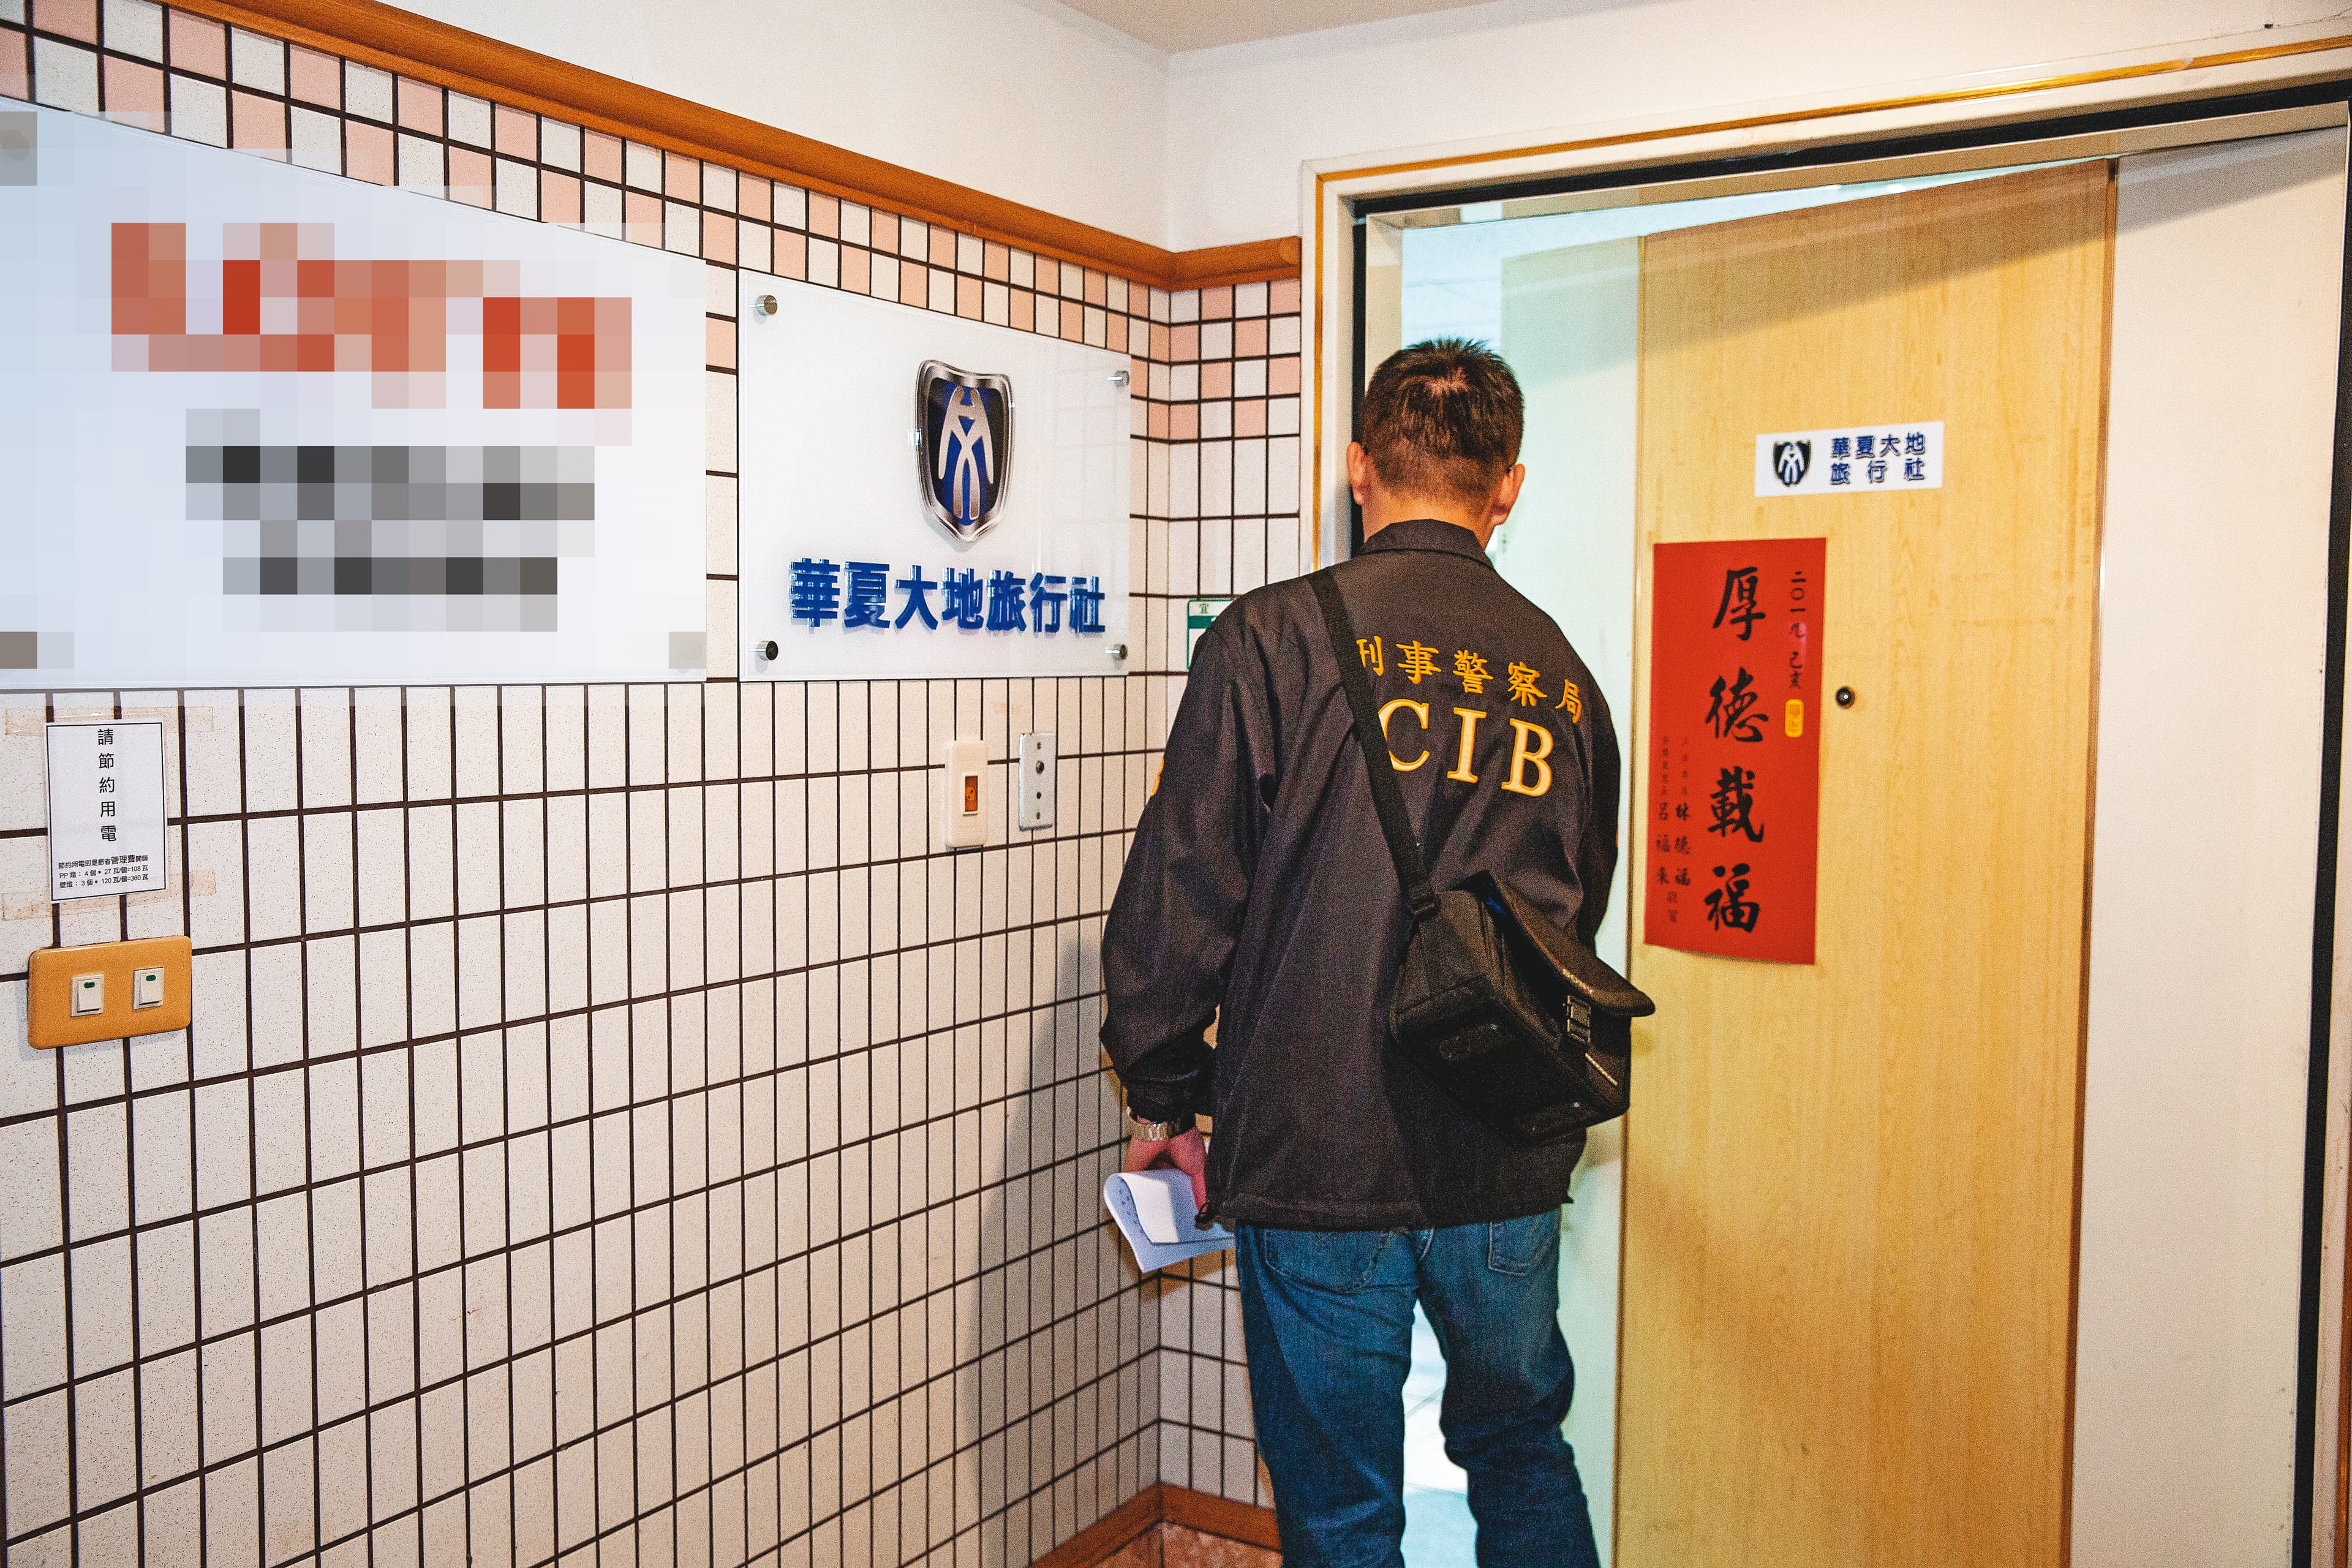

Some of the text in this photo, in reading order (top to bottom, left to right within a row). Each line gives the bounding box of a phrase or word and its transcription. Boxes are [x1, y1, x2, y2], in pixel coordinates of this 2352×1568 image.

[1830, 458, 1925, 485] 旅行社
[1831, 432, 1926, 458] 華夏大地
[788, 557, 1106, 633] 華夏大地旅行社
[97, 728, 117, 843] 請節約用電
[1378, 698, 1555, 797] CIB
